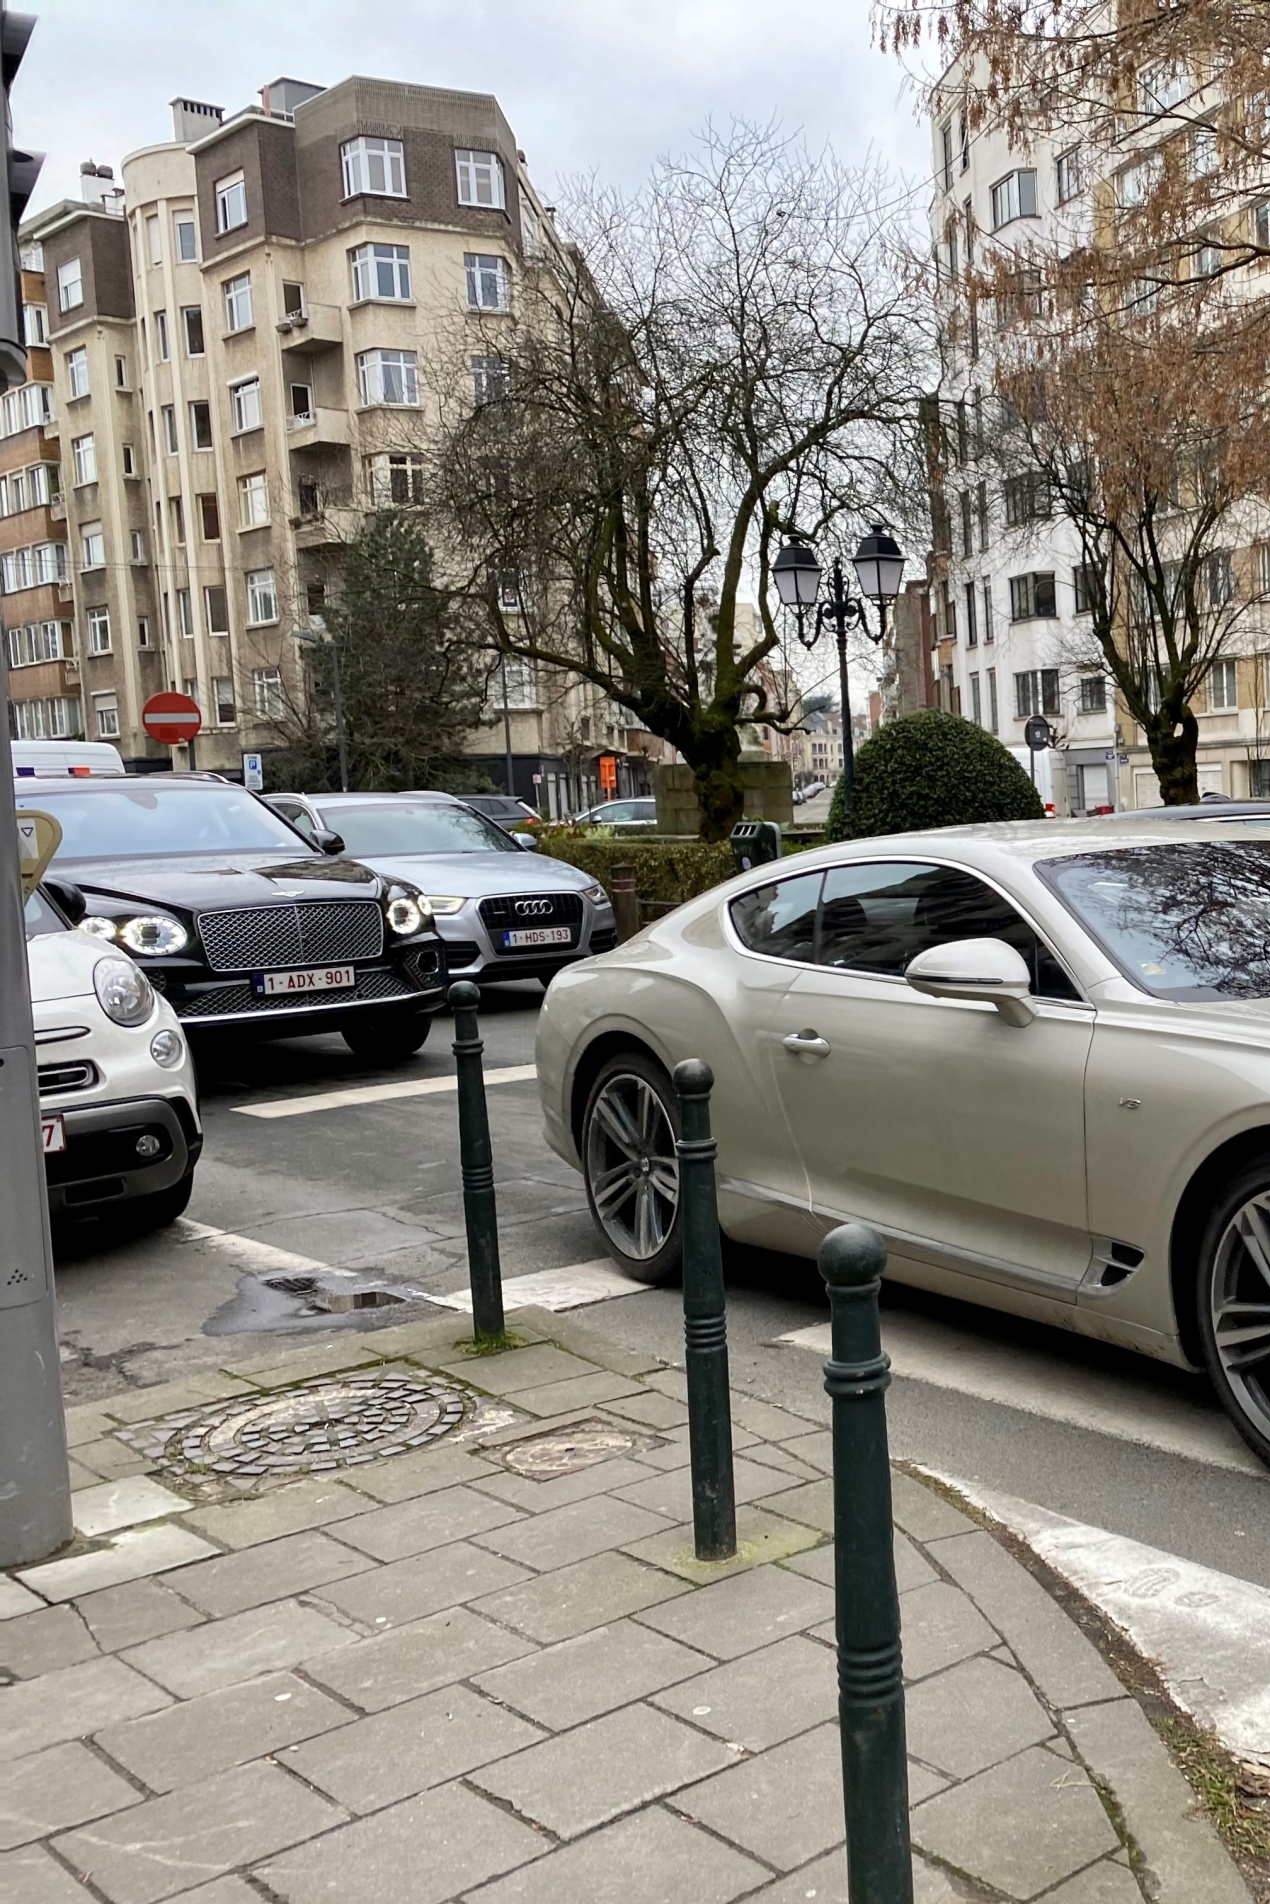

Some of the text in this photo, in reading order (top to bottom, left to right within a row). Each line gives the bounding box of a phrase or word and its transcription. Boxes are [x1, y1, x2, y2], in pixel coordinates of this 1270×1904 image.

[512, 929, 569, 944] 1-HDS-193
[268, 969, 350, 991] 1-ADX-901
[42, 1124, 55, 1148] 7
